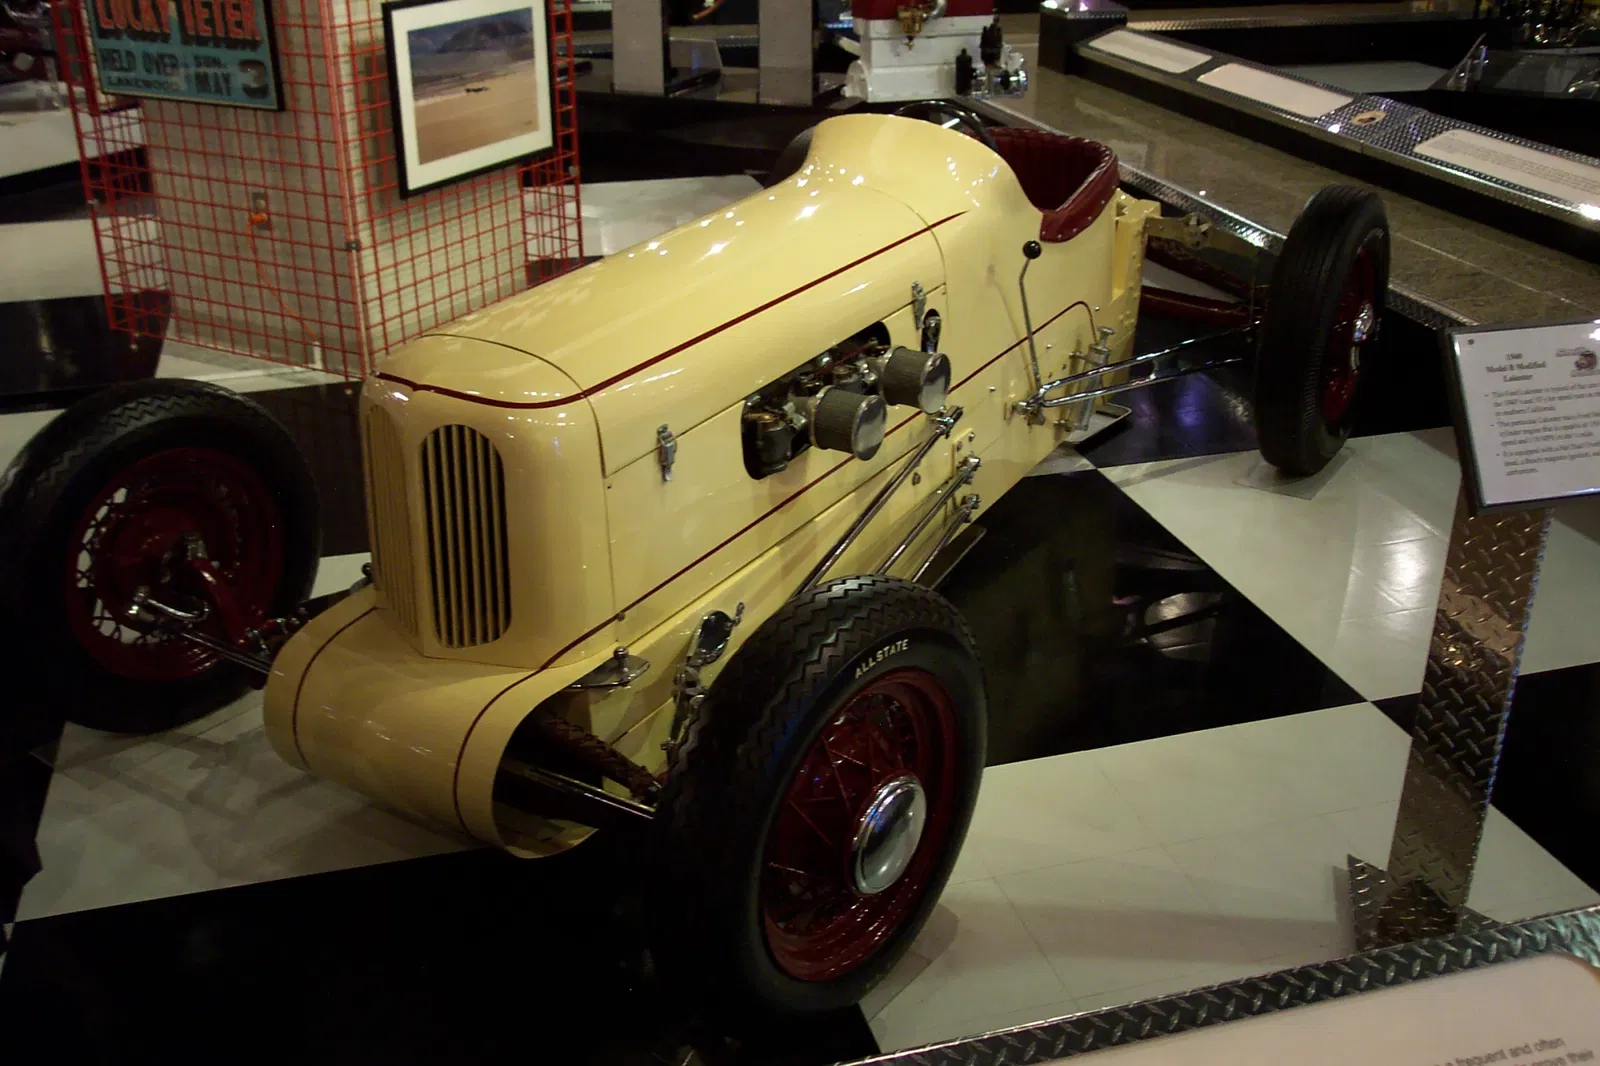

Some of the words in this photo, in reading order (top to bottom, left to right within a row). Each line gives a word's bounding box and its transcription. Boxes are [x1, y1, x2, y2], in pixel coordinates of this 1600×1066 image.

[95, 0, 171, 35] LUCKY
[181, 0, 262, 42] TETER
[100, 48, 136, 72] HELD
[196, 71, 231, 97] MAY
[238, 58, 269, 99] 3
[855, 638, 909, 679] ALLSTATE
[1509, 1042, 1534, 1058] and
[1534, 1037, 1567, 1052] often
